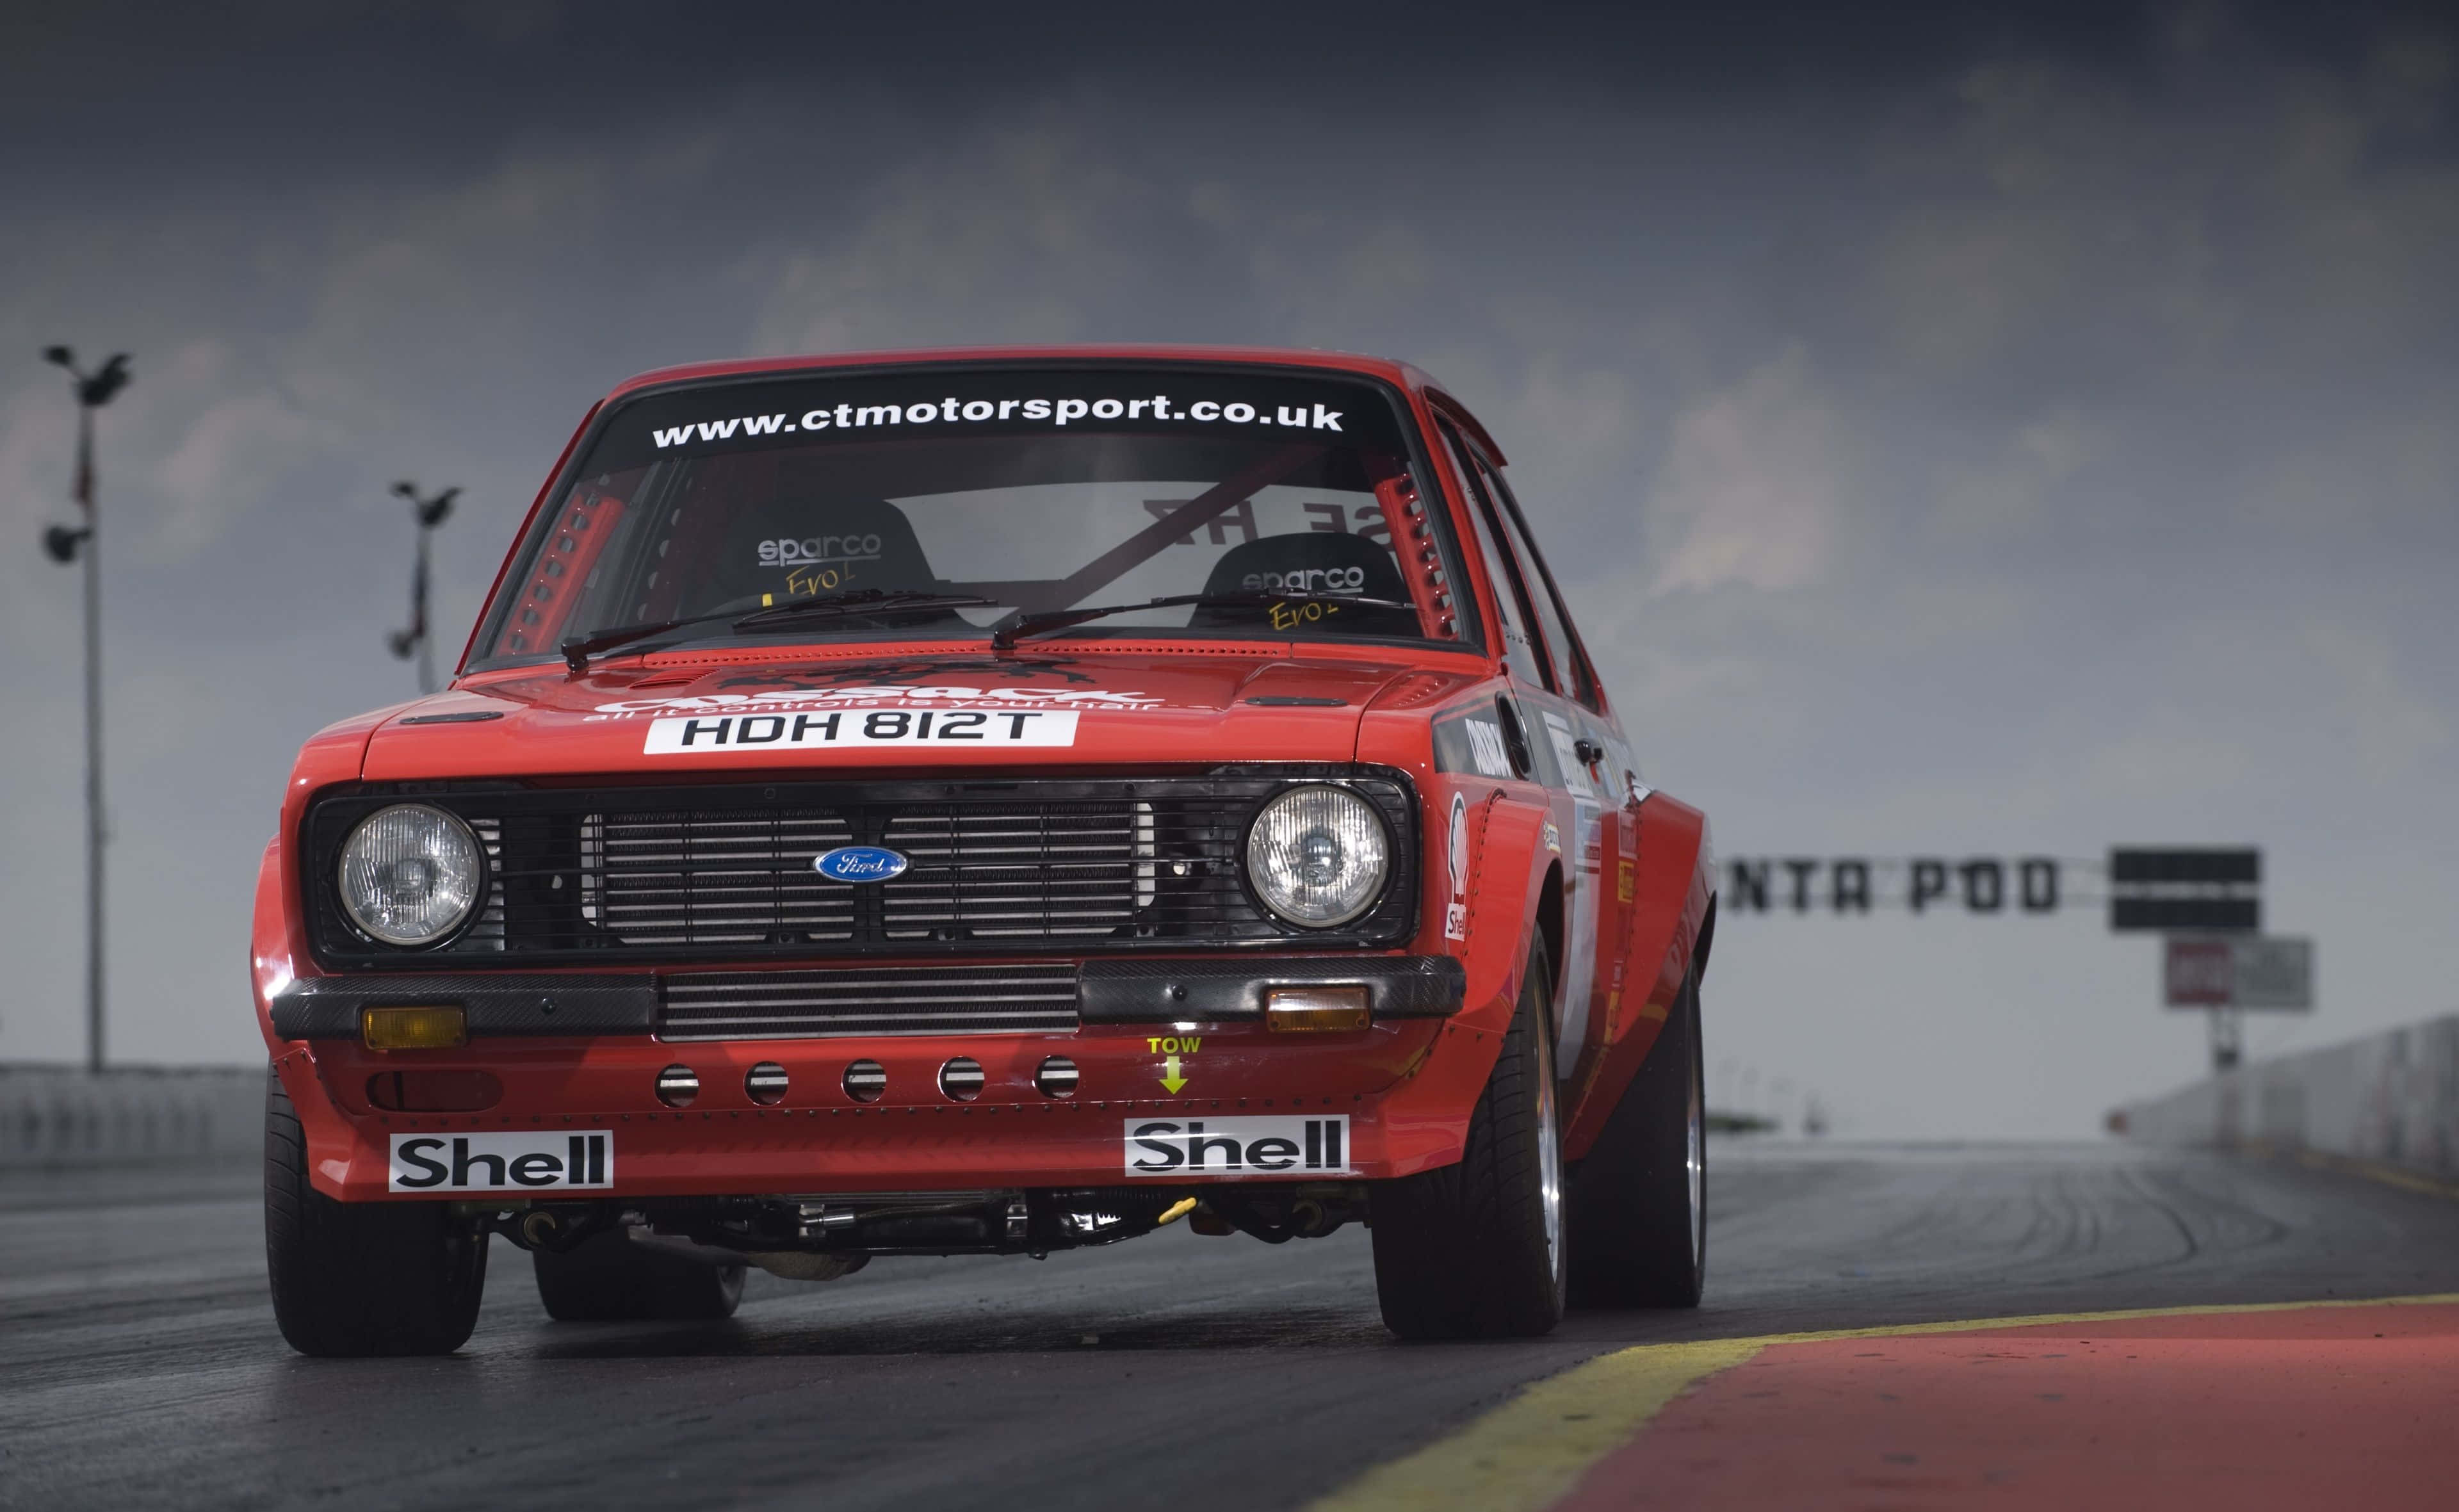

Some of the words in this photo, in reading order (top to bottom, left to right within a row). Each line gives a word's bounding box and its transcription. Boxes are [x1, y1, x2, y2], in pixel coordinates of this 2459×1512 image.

[653, 395, 1343, 448] www.ctmotorsport.co.uk
[758, 534, 881, 567] sparco
[1242, 566, 1364, 590] sparco
[582, 711, 636, 722] all
[652, 708, 680, 717] it
[694, 699, 879, 714] controls
[897, 698, 933, 706] is
[950, 699, 1055, 708] your
[1069, 701, 1159, 711] hair
[681, 713, 842, 746] HDH
[863, 711, 1043, 739] 812T
[836, 853, 886, 874] Ford
[1730, 858, 1870, 913] NTA
[1908, 858, 2059, 913] POD
[1448, 910, 1466, 935] Shel
[1147, 1037, 1201, 1053] TOW
[395, 1135, 605, 1188] Shell
[1132, 1119, 1342, 1173] Shell
